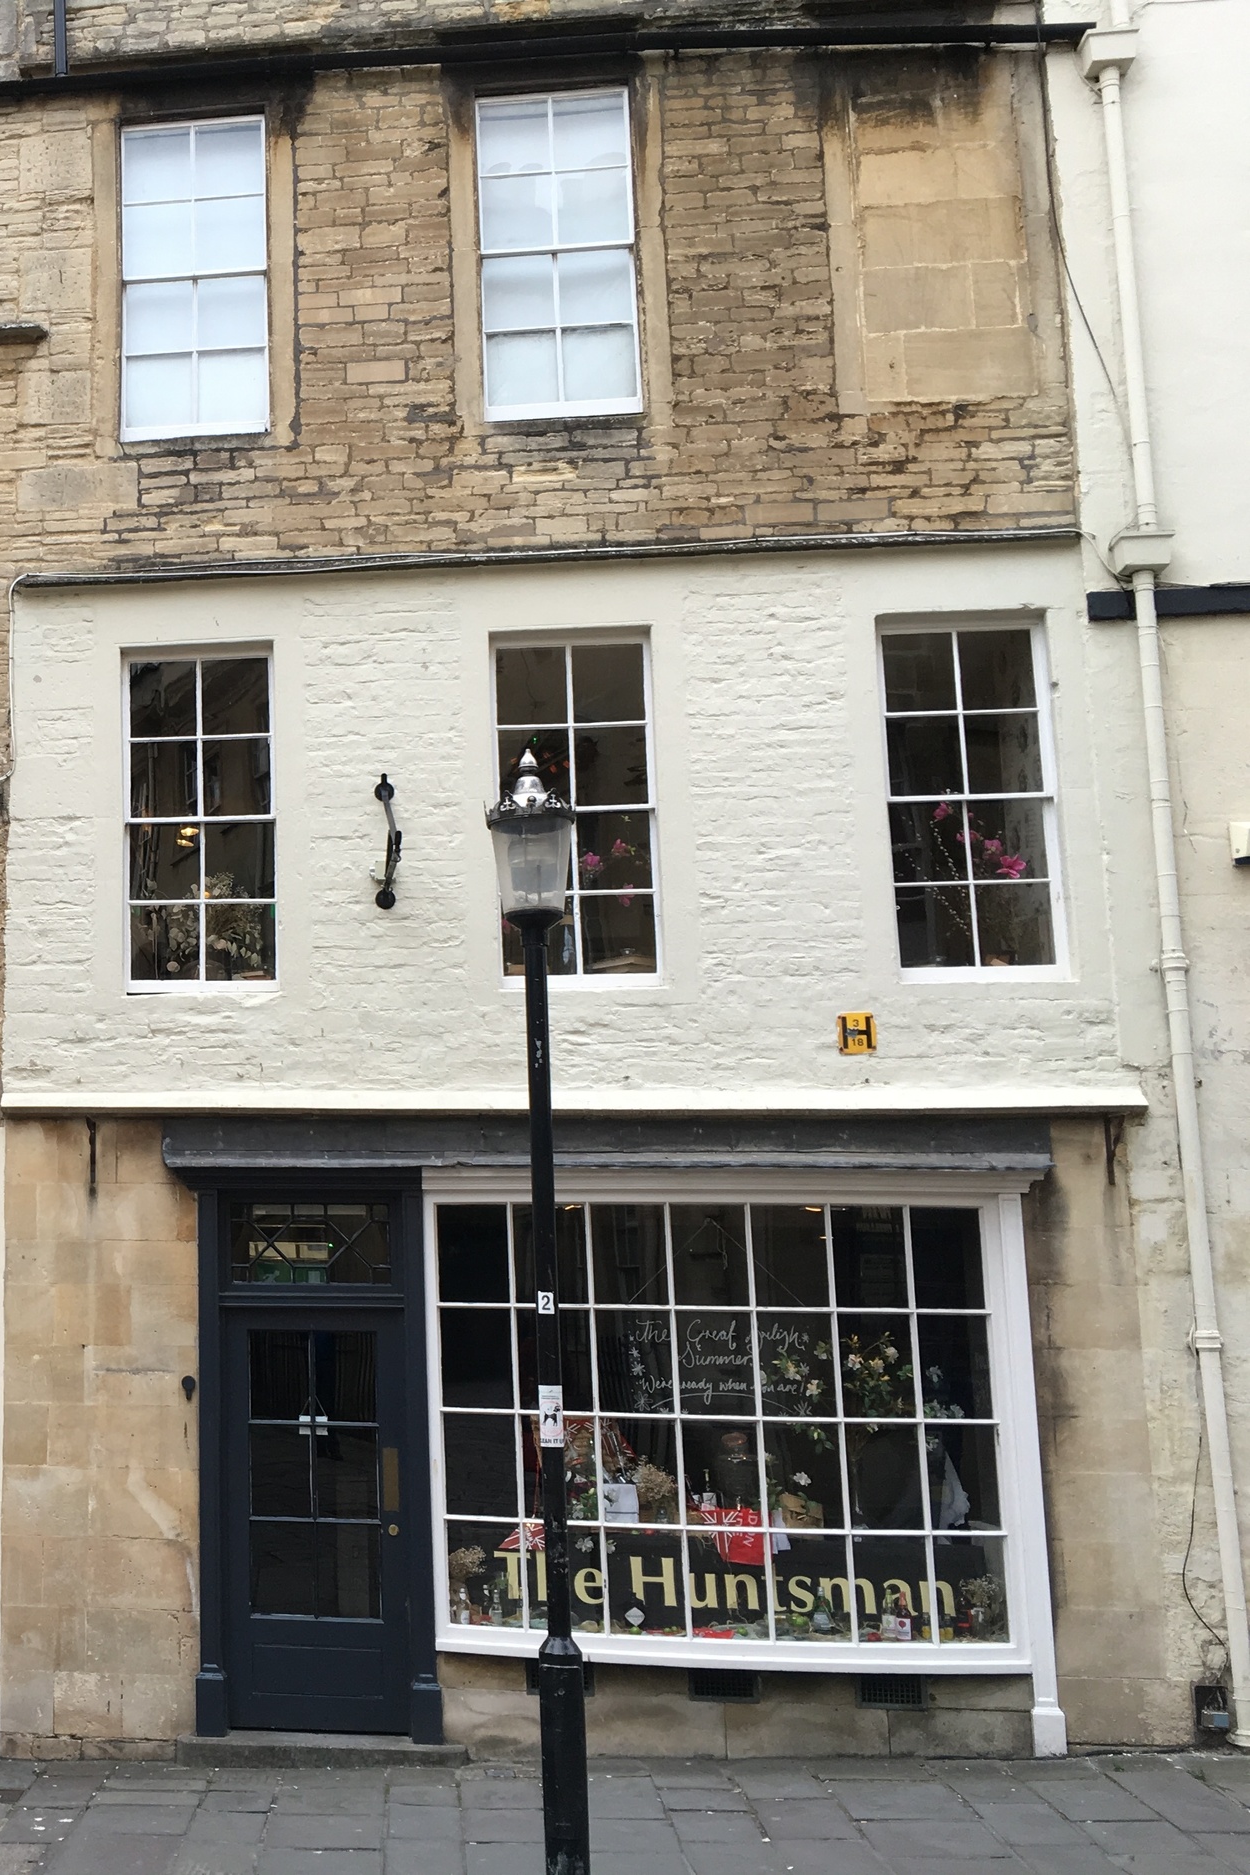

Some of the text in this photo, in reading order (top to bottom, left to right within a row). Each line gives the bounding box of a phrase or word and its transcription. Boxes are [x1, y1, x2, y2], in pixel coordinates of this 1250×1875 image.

[841, 1016, 872, 1049] H
[852, 1019, 859, 1027] 3
[851, 1037, 864, 1046] 18
[541, 1294, 551, 1311] 2
[636, 1319, 670, 1342] The
[687, 1319, 737, 1351] Great
[680, 1378, 713, 1405] ready
[719, 1378, 747, 1391] when
[629, 1556, 958, 1617] Huntsman
